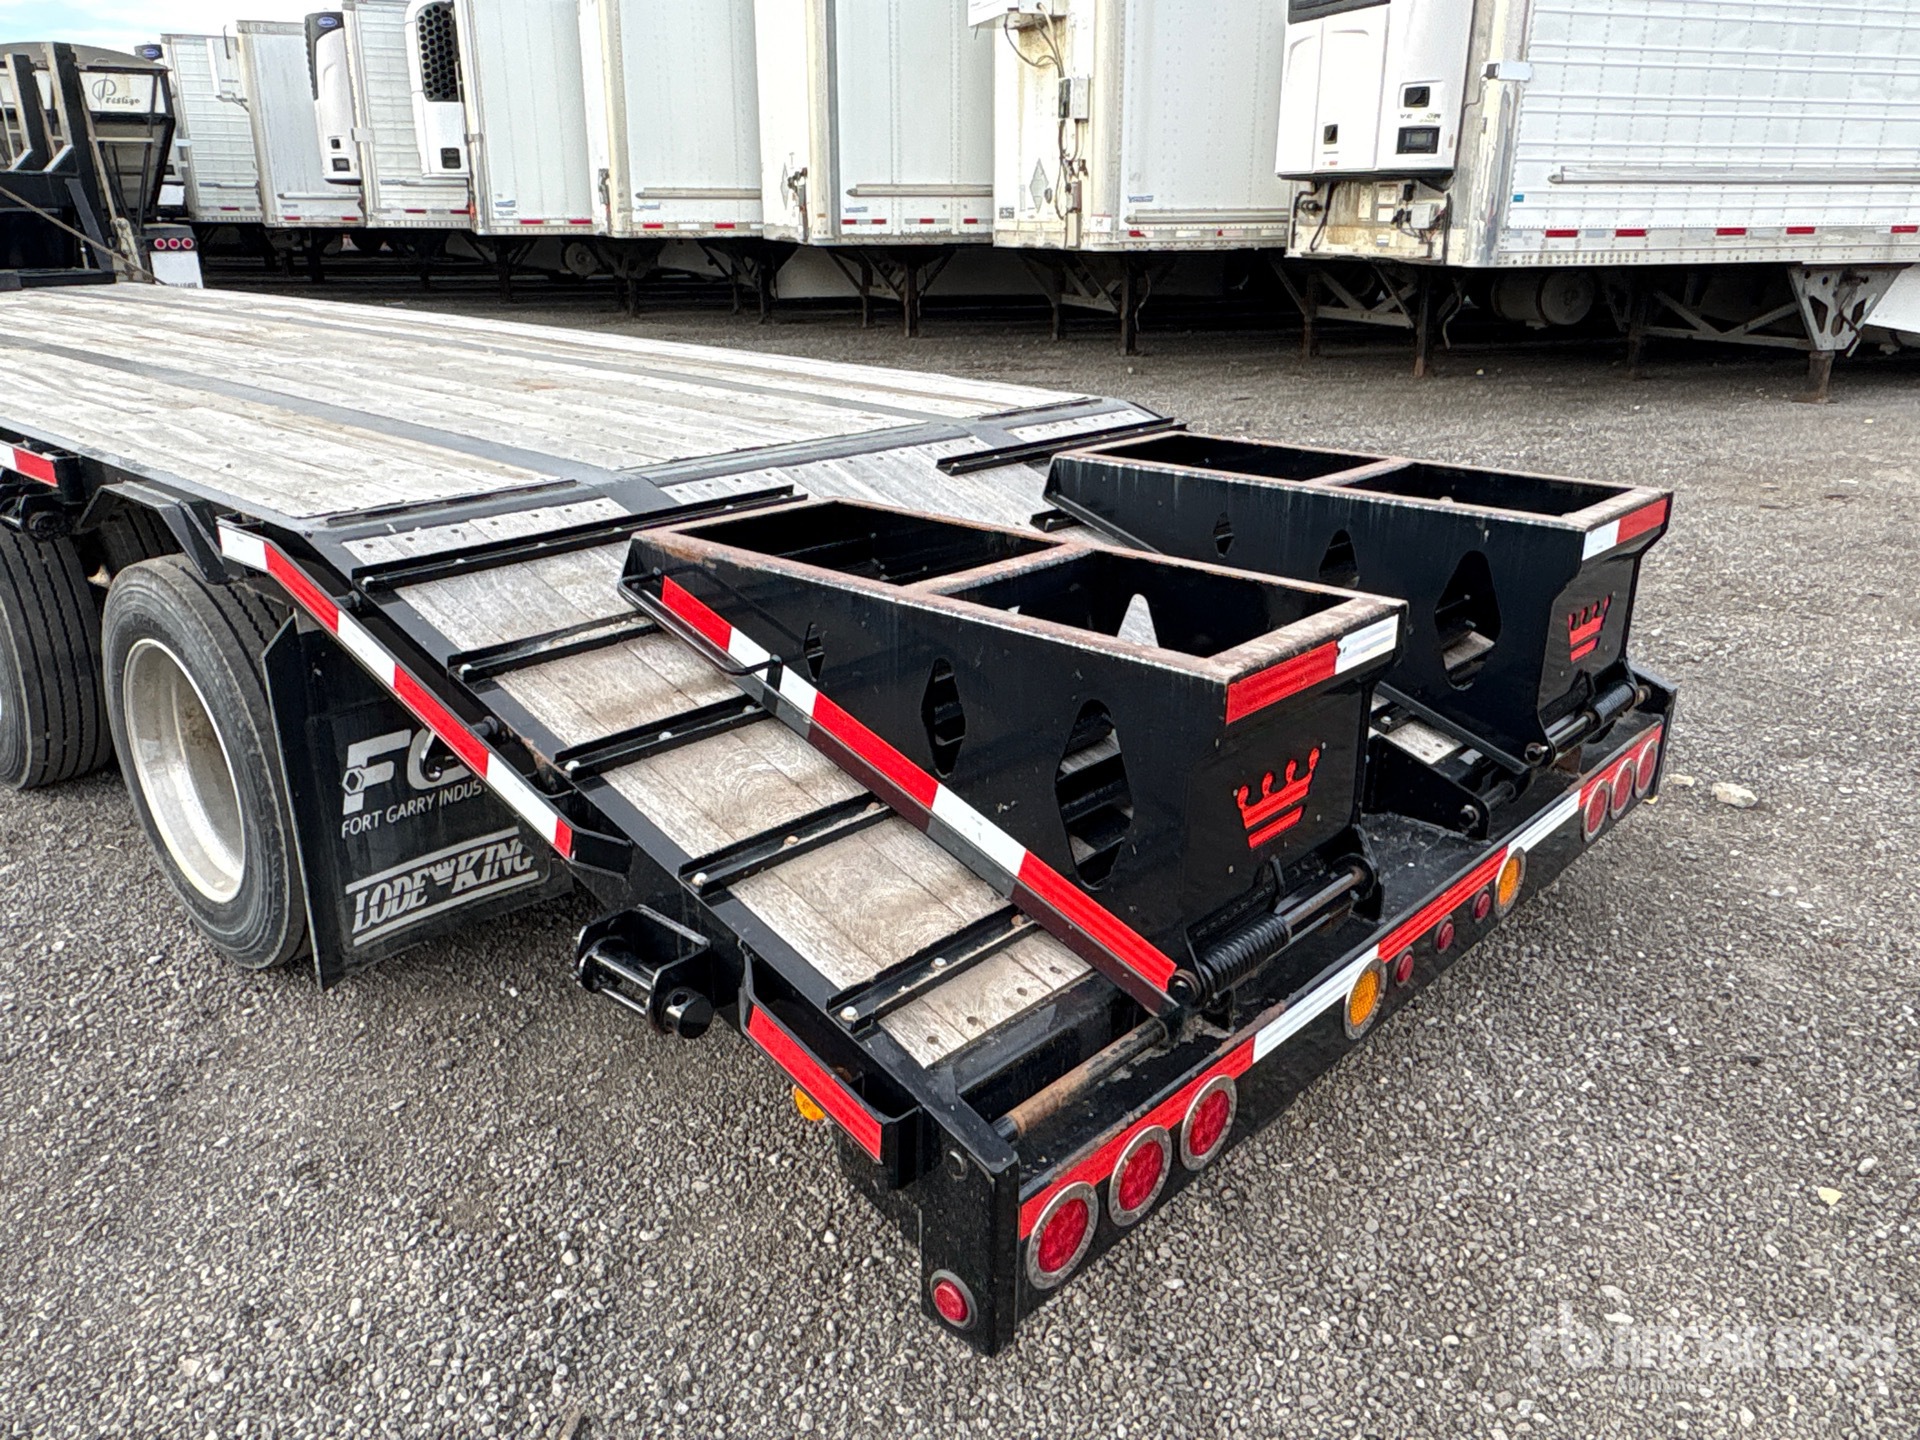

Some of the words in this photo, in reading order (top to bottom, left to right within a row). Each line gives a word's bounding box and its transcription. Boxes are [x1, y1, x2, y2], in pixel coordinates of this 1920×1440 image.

[341, 810, 382, 839] FORT
[386, 793, 435, 823] GARRY
[438, 781, 487, 808] INDUS
[352, 873, 430, 935] LODE
[452, 838, 535, 895] KING
